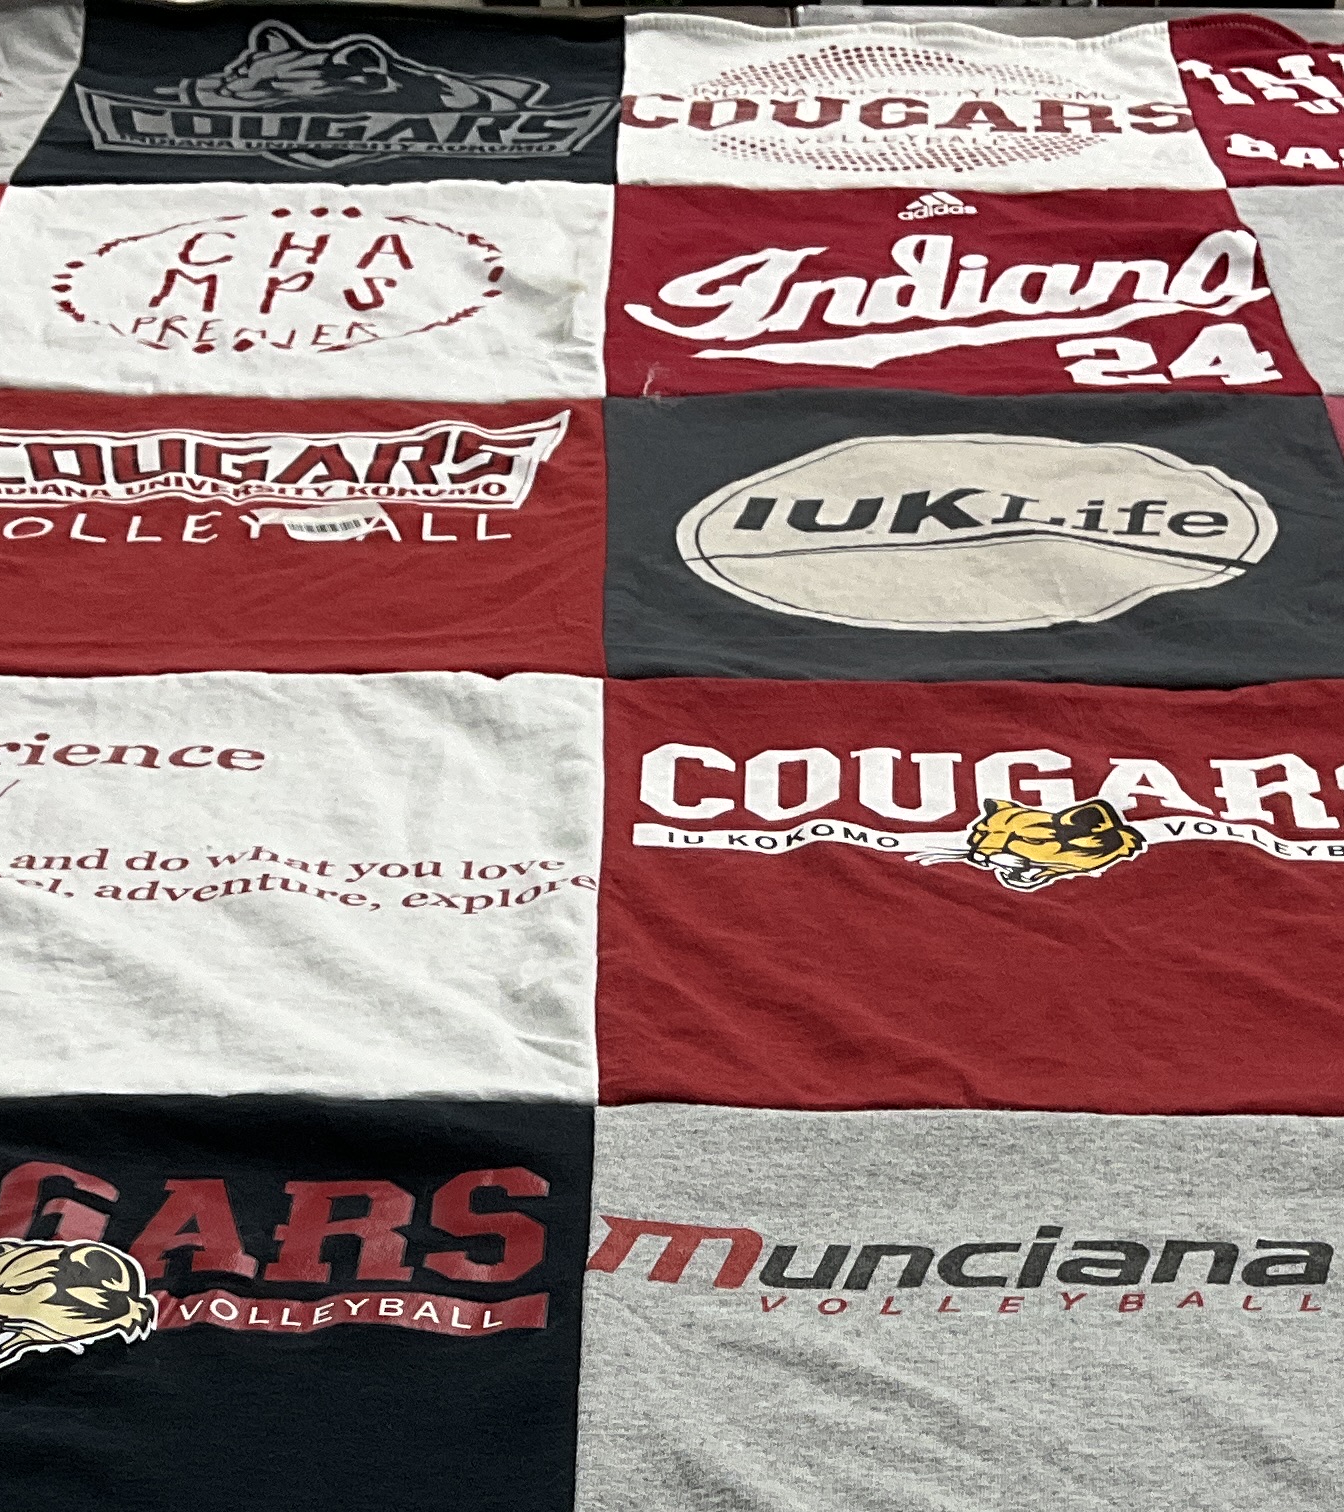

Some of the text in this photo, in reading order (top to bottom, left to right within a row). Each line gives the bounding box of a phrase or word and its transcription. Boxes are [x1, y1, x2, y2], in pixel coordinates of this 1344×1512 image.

[109, 103, 592, 143] COUGARS
[620, 94, 1195, 134] COUGARS
[897, 203, 978, 222] adidas
[624, 230, 1271, 342] Indiana
[1056, 323, 1283, 386] 24
[125, 475, 334, 498] UNIVERSITY
[667, 831, 704, 845] IU
[728, 823, 900, 850] KOKOMO
[9, 847, 109, 872] and
[125, 849, 190, 872] do
[207, 845, 337, 877] what
[345, 858, 443, 883] you
[461, 859, 566, 881] love
[95, 872, 382, 911] adventure,
[400, 873, 598, 914] explore
[178, 1297, 504, 1331] VOLLEYBALL
[759, 1293, 1326, 1316] VOLLEYBALL
